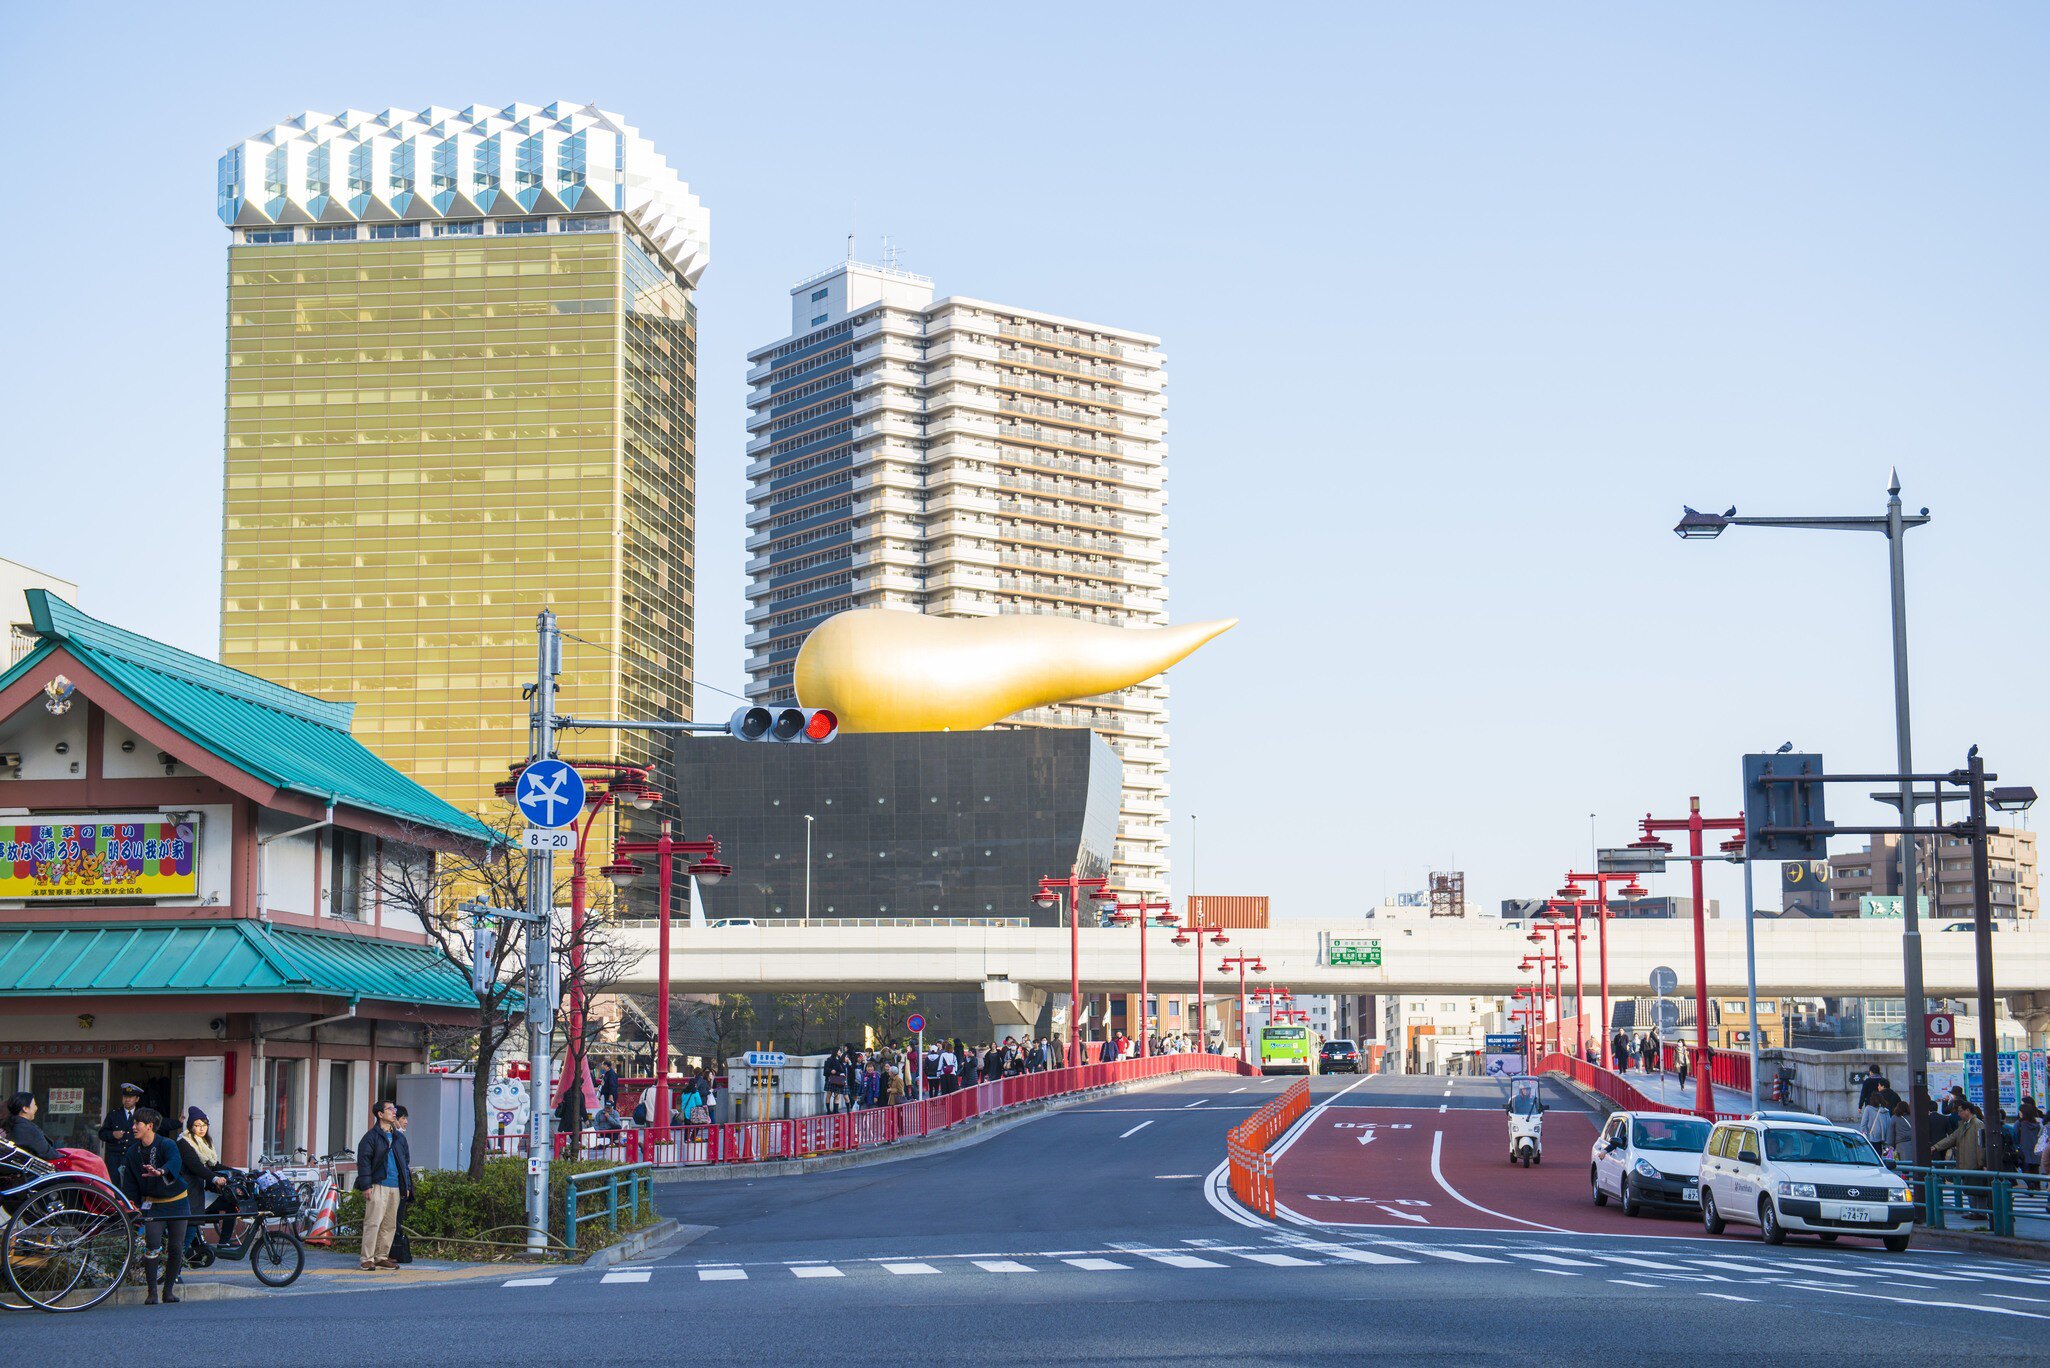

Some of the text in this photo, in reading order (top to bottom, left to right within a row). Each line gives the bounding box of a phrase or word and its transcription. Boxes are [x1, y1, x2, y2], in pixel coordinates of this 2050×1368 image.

[40, 825, 135, 839] 浅草の願い
[107, 839, 184, 860] 明るい我が家
[1847, 1212, 1869, 1221] 74-77
